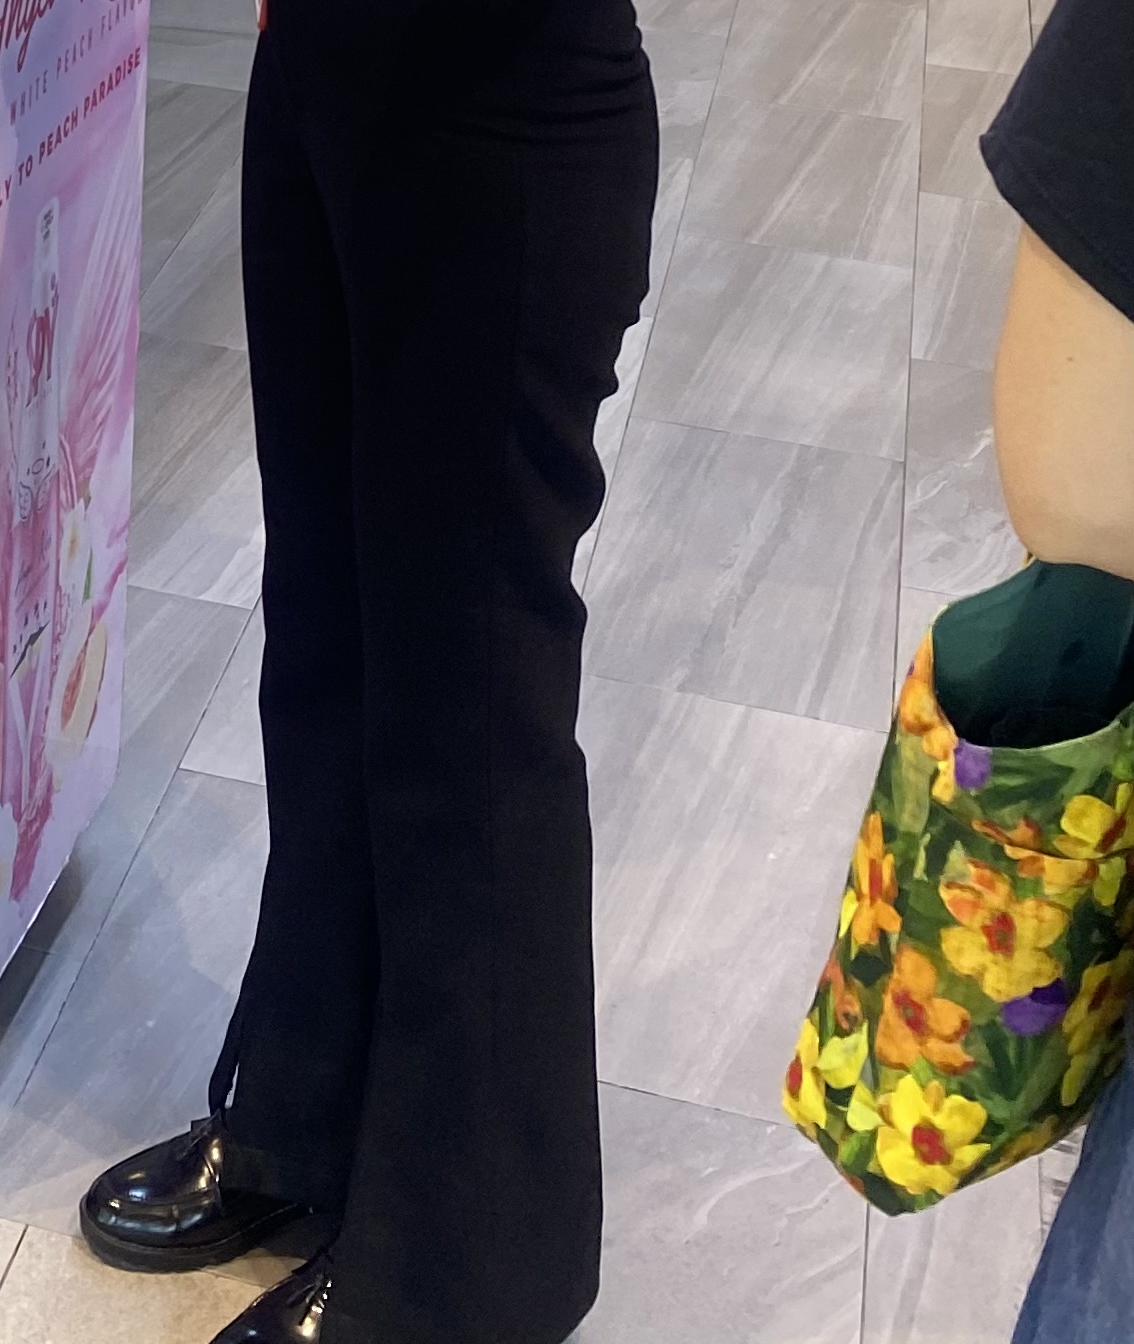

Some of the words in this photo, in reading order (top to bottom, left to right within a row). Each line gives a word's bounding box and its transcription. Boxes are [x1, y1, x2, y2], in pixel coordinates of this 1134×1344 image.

[9, 69, 49, 127] WHITE
[56, 27, 94, 82] PEACH
[18, 154, 34, 186] TO
[38, 106, 79, 165] PEACH
[84, 47, 142, 120] PARADISE
